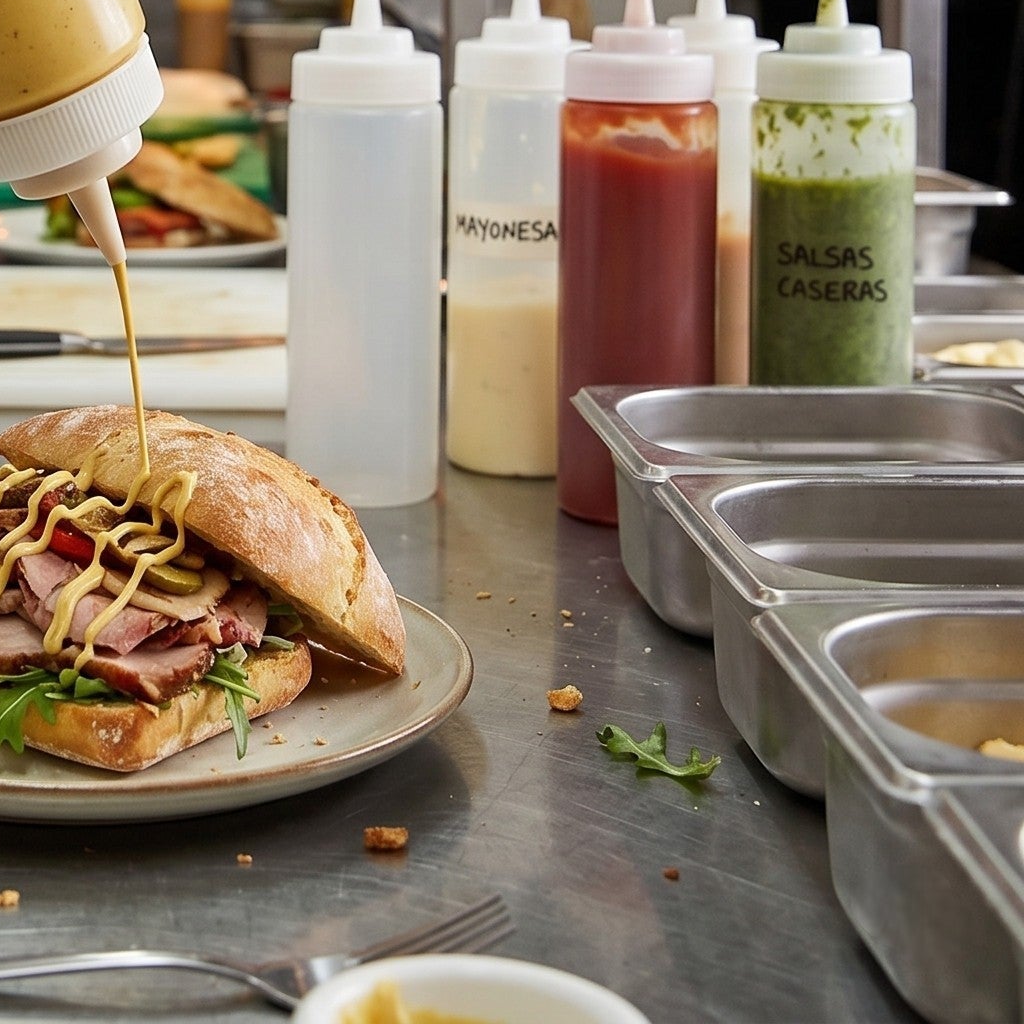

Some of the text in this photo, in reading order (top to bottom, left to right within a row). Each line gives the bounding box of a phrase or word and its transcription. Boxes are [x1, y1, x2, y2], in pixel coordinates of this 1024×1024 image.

[456, 214, 558, 243] MAYONESA
[777, 241, 874, 271] SALSAS
[777, 276, 888, 303] CASERAS
